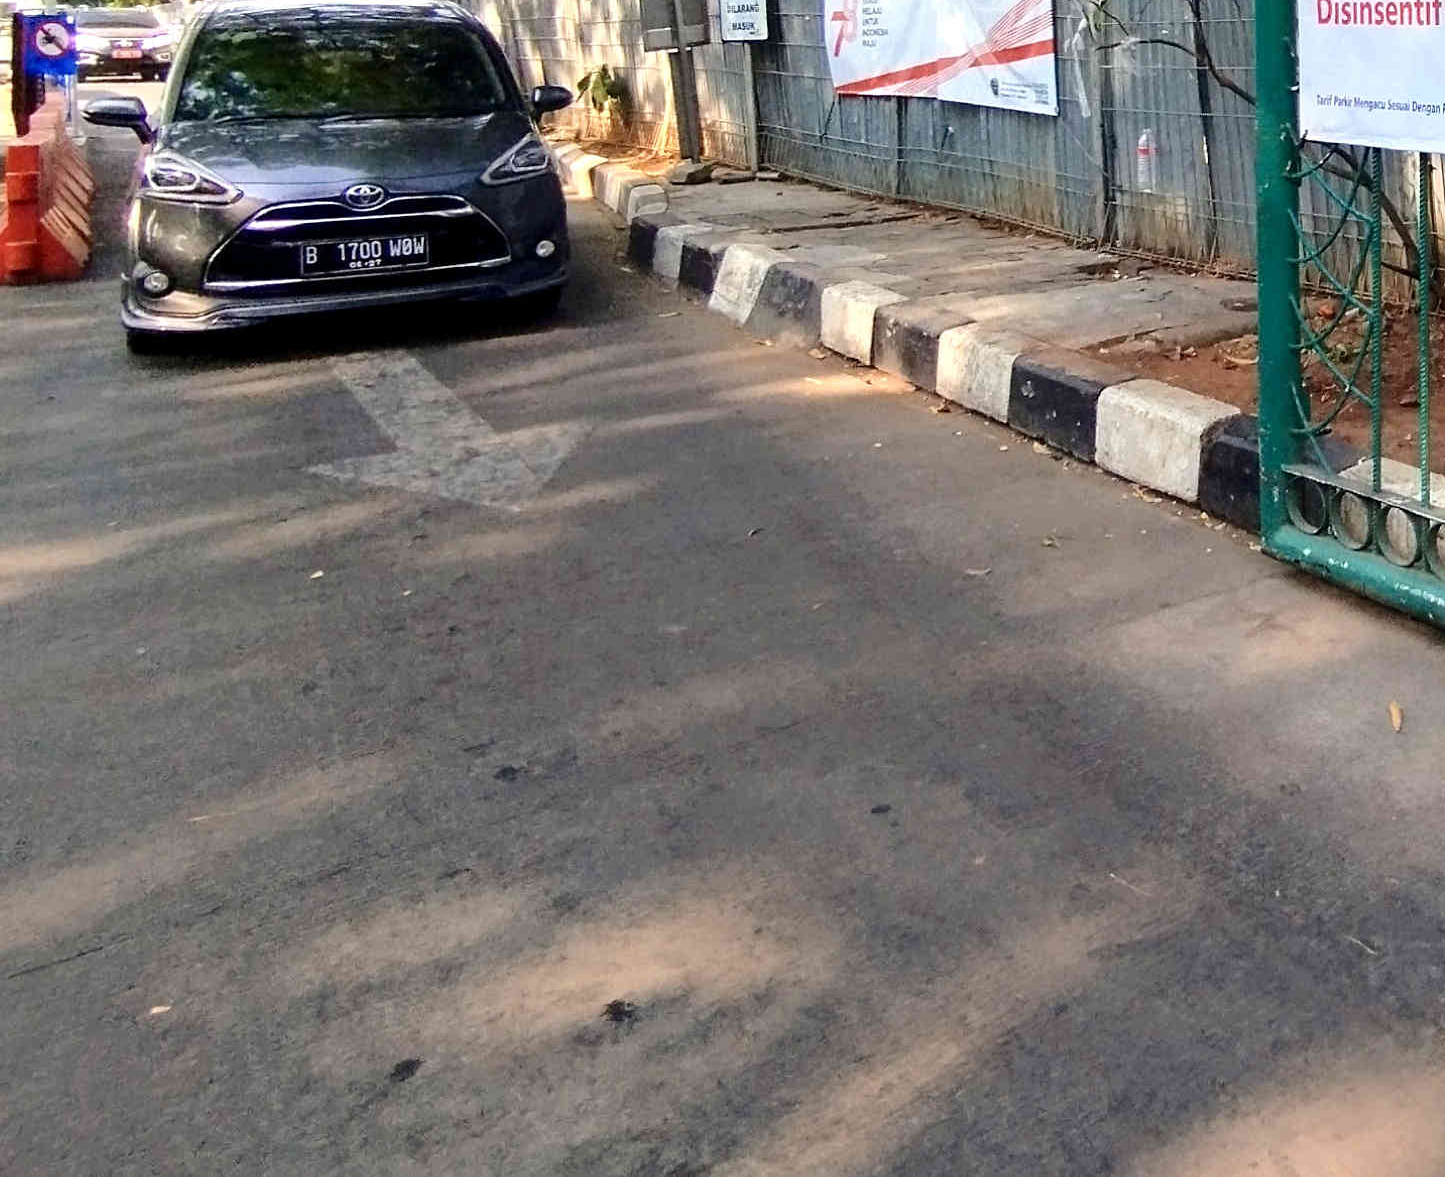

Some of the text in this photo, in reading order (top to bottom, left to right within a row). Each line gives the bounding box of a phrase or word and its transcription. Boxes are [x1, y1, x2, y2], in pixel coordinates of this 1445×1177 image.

[1317, 94, 1332, 106] Tarif
[1334, 96, 1352, 108] Parkir
[1354, 97, 1385, 112] Mengacu
[1388, 100, 1410, 111] Sesuai
[1412, 101, 1440, 116] Dengan
[305, 246, 317, 264] B
[337, 241, 382, 261] 1700
